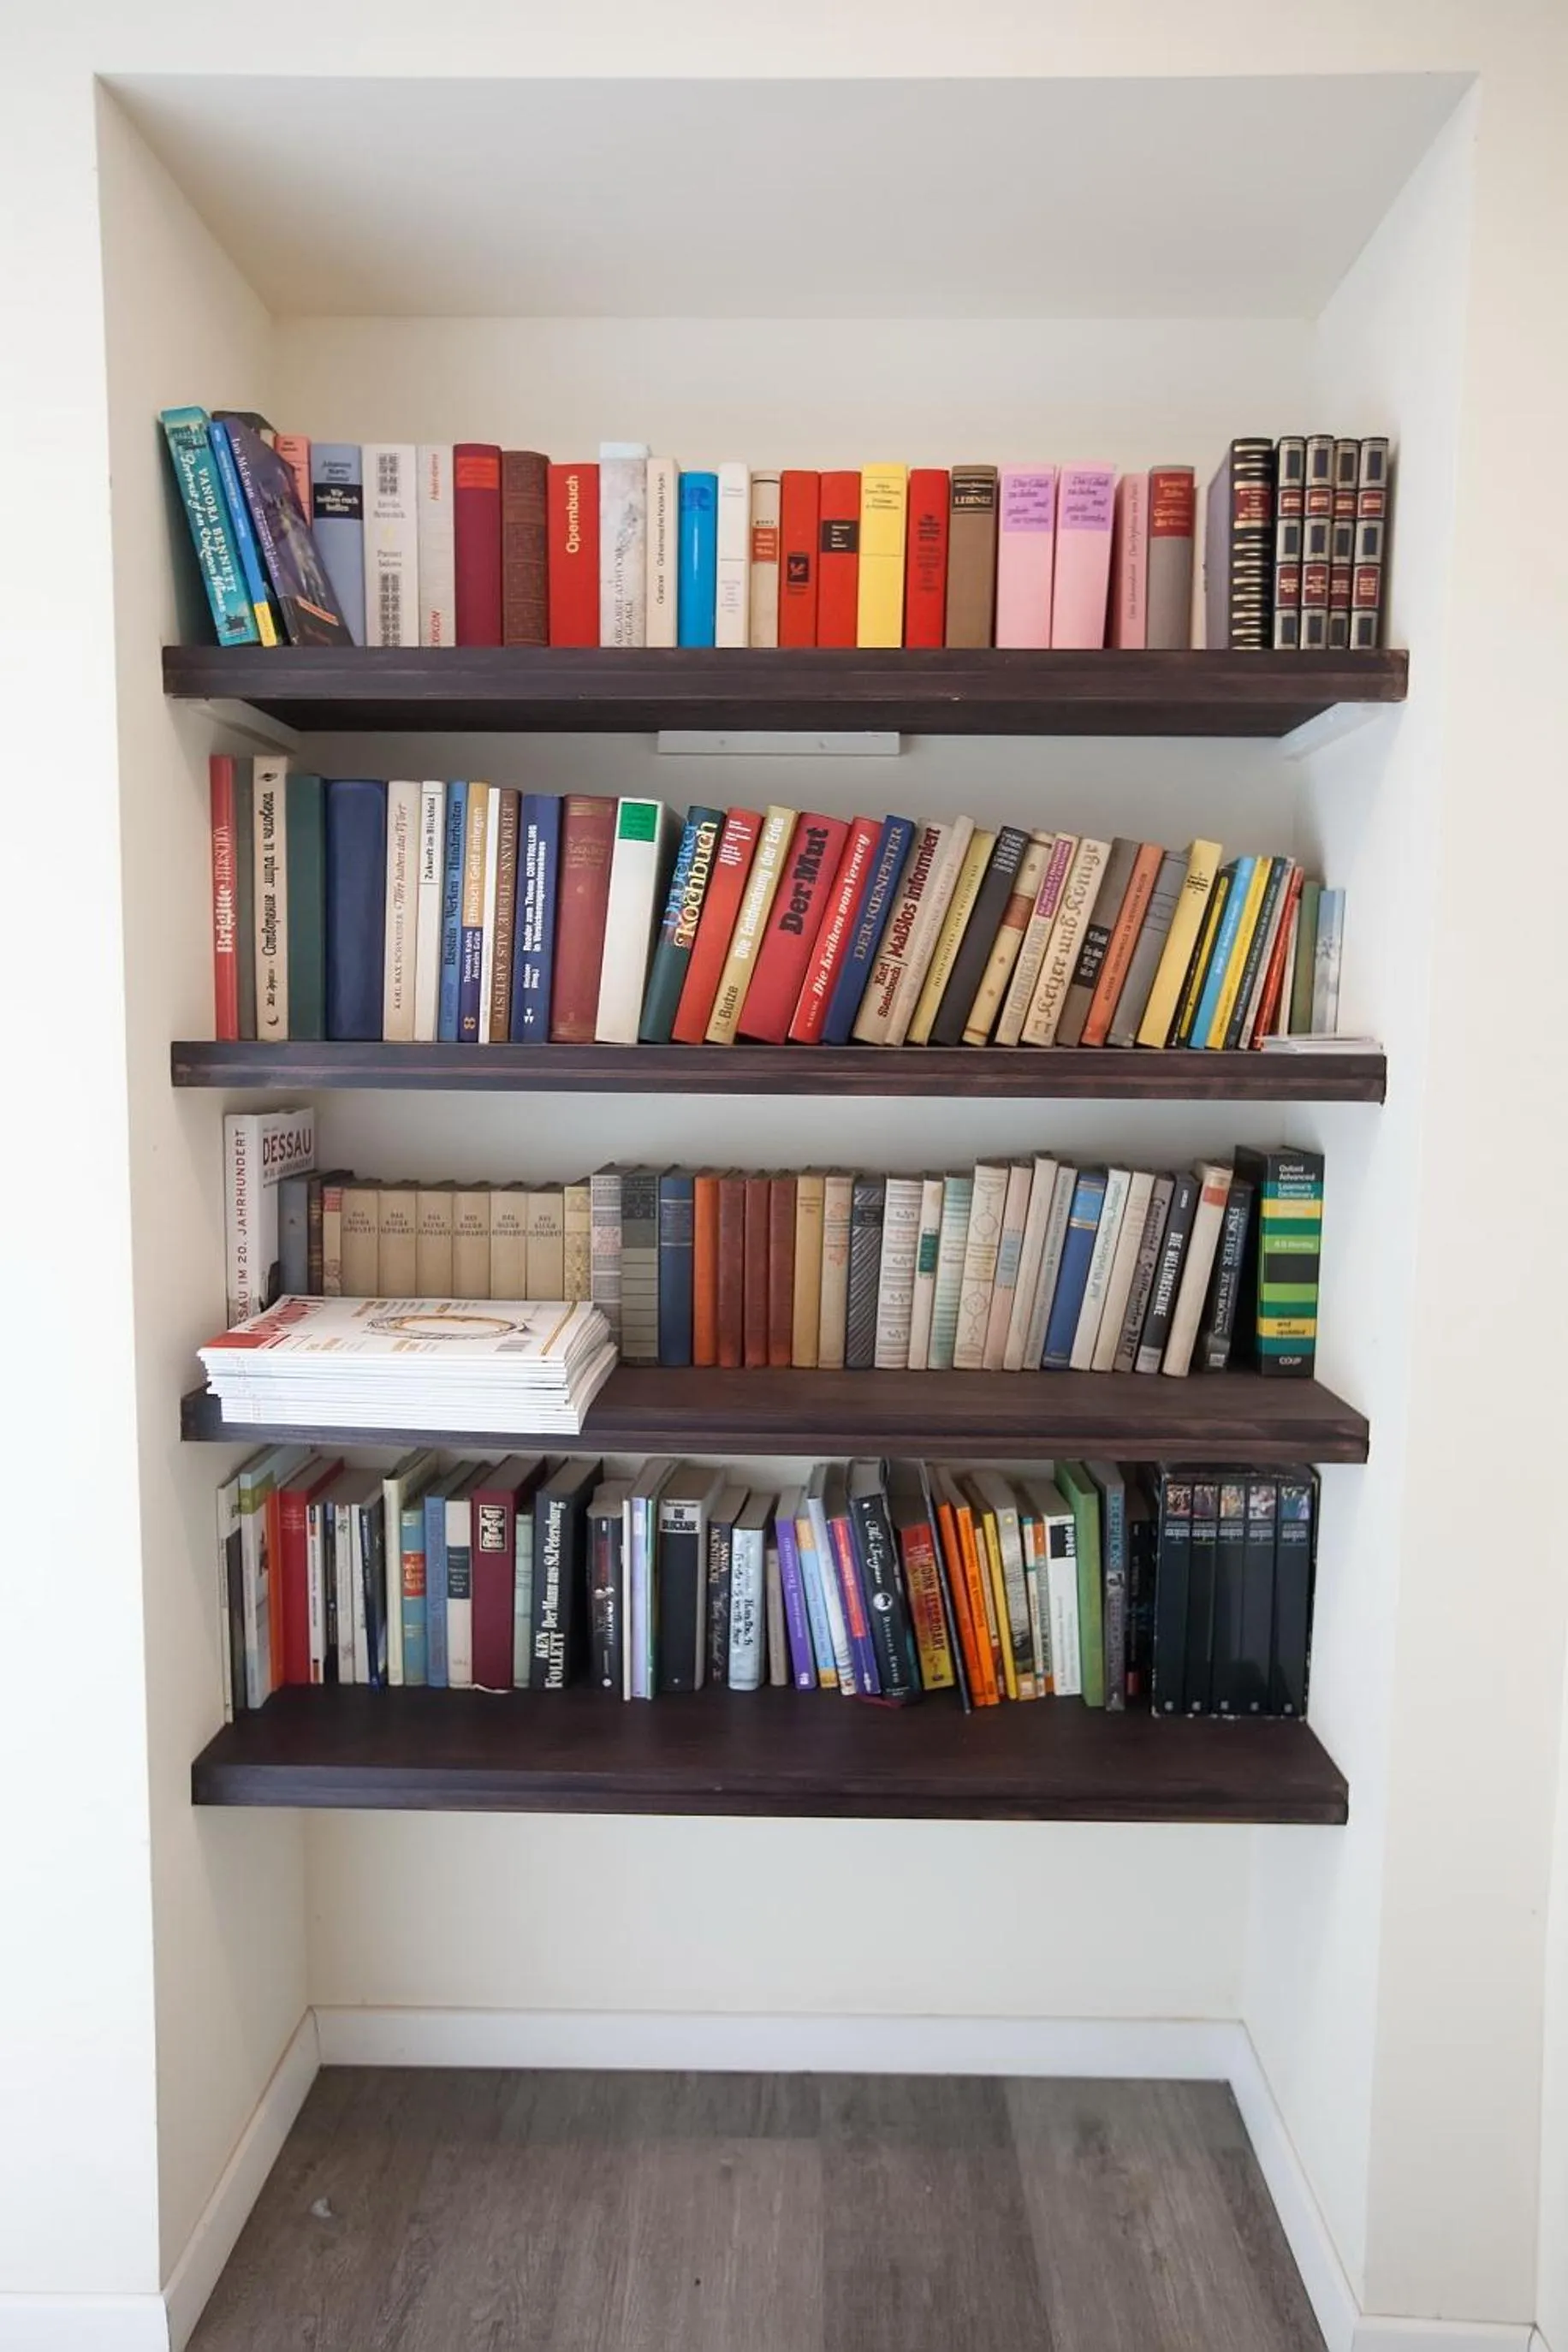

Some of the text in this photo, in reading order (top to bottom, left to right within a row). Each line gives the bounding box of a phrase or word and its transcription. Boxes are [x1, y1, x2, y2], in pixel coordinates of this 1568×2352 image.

[180, 452, 199, 499] Portrait
[232, 438, 255, 500] Ian McEwan
[199, 468, 220, 523] VANORA
[213, 527, 237, 592] BENNETT
[565, 473, 579, 555] Opernbuch
[258, 790, 276, 840] человека
[395, 803, 408, 834] Wort
[264, 841, 275, 852] и
[395, 834, 408, 852] das
[424, 797, 437, 880] Zukunft im Blickfeld
[527, 824, 538, 877] CONTROLLING
[264, 855, 280, 888] мира
[394, 852, 407, 882] haben
[445, 800, 462, 965] Basteln Werken Handarbeiten
[468, 806, 484, 924] Ethisch Geld anlegen
[674, 821, 719, 947] Kochbuch
[778, 826, 830, 935] Der Mut
[844, 833, 872, 894] Verney
[1066, 843, 1101, 916] Könige
[526, 879, 537, 906] Thema
[838, 892, 853, 923] von
[854, 826, 905, 960] DER KIENPETER
[887, 826, 941, 960] Maßlos informiert
[214, 885, 236, 953] Brigitte
[260, 893, 281, 957] Сотворение
[526, 906, 534, 923] zum
[717, 817, 786, 1019] Butze Die Entdeckung der Erde
[471, 930, 481, 980] Anselm Grün
[496, 931, 508, 957] ALS
[523, 924, 533, 952] Reader
[818, 920, 845, 971] Krähen
[1059, 918, 1079, 954] und
[394, 965, 403, 984] MAX
[463, 955, 472, 983] Thomas
[812, 969, 829, 997] Die
[874, 963, 890, 988] Karl
[1038, 963, 1066, 1014] Ketzer
[394, 986, 402, 1011] KARL
[493, 963, 508, 1020] ARTISTE
[876, 966, 902, 1019] Steinbuch
[263, 1128, 312, 1166] DESSAU
[235, 1129, 247, 1235] JAHRHUNDERT
[1279, 1164, 1304, 1173] Oxford
[237, 1239, 248, 1264] 20.
[1169, 1231, 1184, 1251] DIE
[1222, 1206, 1241, 1267] FISCHER
[238, 1269, 247, 1285] IM
[545, 1500, 567, 1553] Petersburg
[1064, 1525, 1076, 1558] PIPER
[1110, 1494, 1123, 1568] DECEPTIONS
[548, 1565, 560, 1583] aus
[719, 1541, 729, 1572] SANTA
[924, 1559, 938, 1591] JOHN
[542, 1584, 560, 1611] Mann
[541, 1611, 559, 1629] Der
[535, 1630, 550, 1659] KEN
[543, 1631, 565, 1689] FOLLETT
